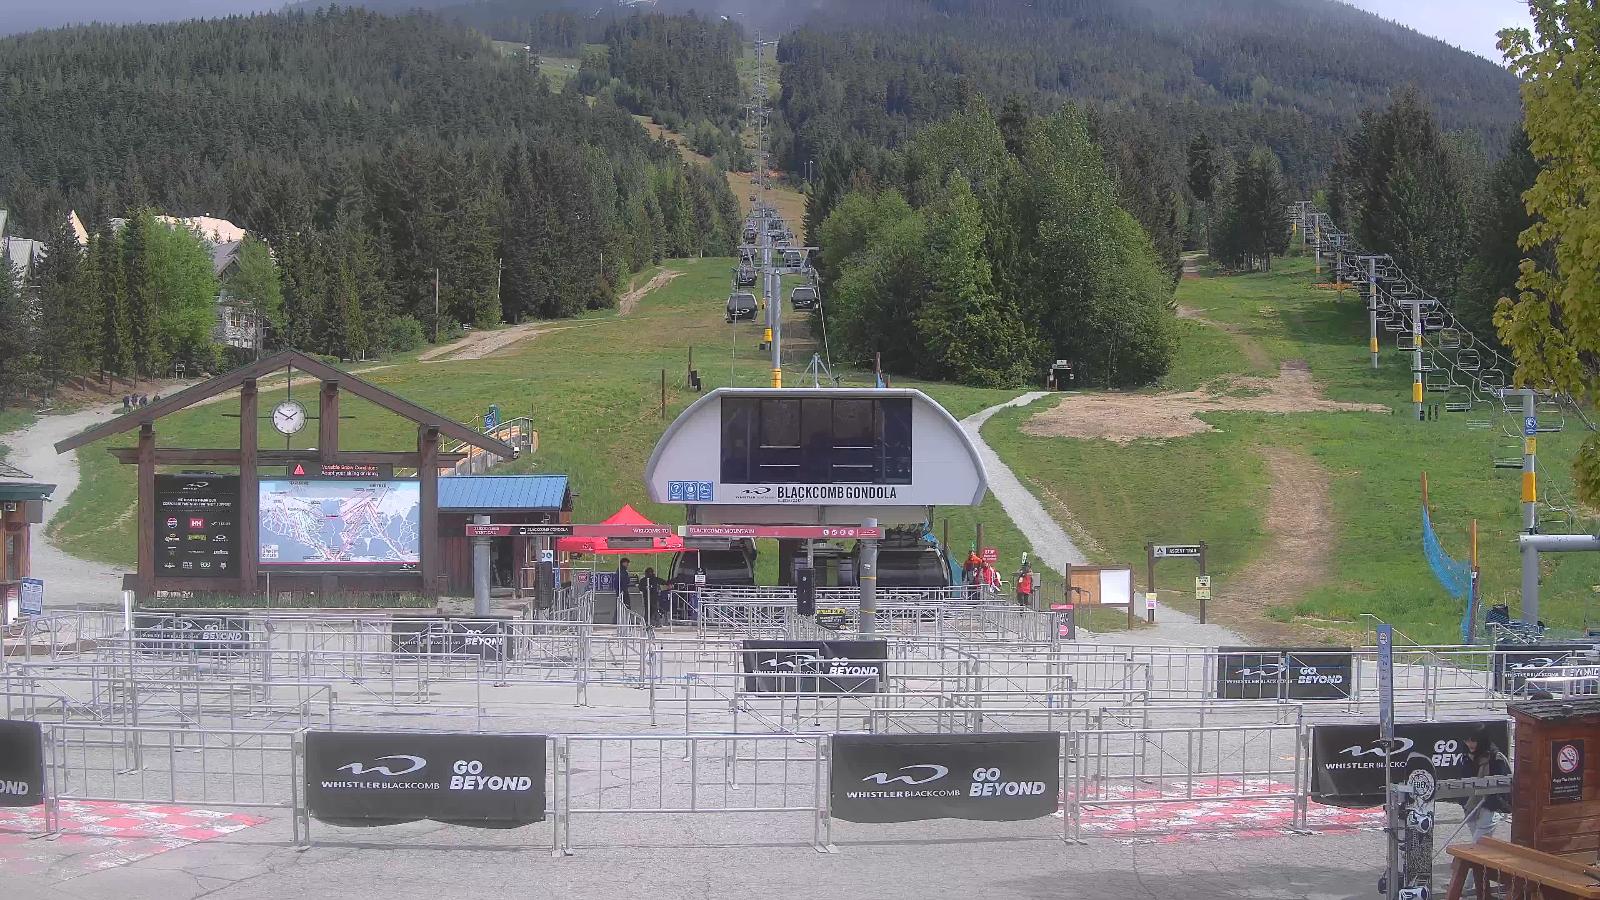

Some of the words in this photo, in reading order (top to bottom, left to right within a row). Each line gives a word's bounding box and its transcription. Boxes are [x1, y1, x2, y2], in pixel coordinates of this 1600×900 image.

[777, 486, 843, 499] BLACKCOMB
[846, 486, 897, 499] GONDOLA
[829, 666, 879, 675] BEYOND
[1300, 667, 1317, 675] GO
[1298, 675, 1343, 684] BEYOND
[1434, 739, 1458, 753] GO
[453, 760, 483, 774] GO
[972, 767, 1001, 781] GO
[321, 781, 382, 789] WHISTLER
[382, 782, 440, 790] BLACKCOMB
[449, 775, 532, 791] BEYOND
[969, 781, 1046, 797] BEYOND
[846, 790, 904, 799] WHISTLER
[904, 789, 961, 797] BLACKCOMB
